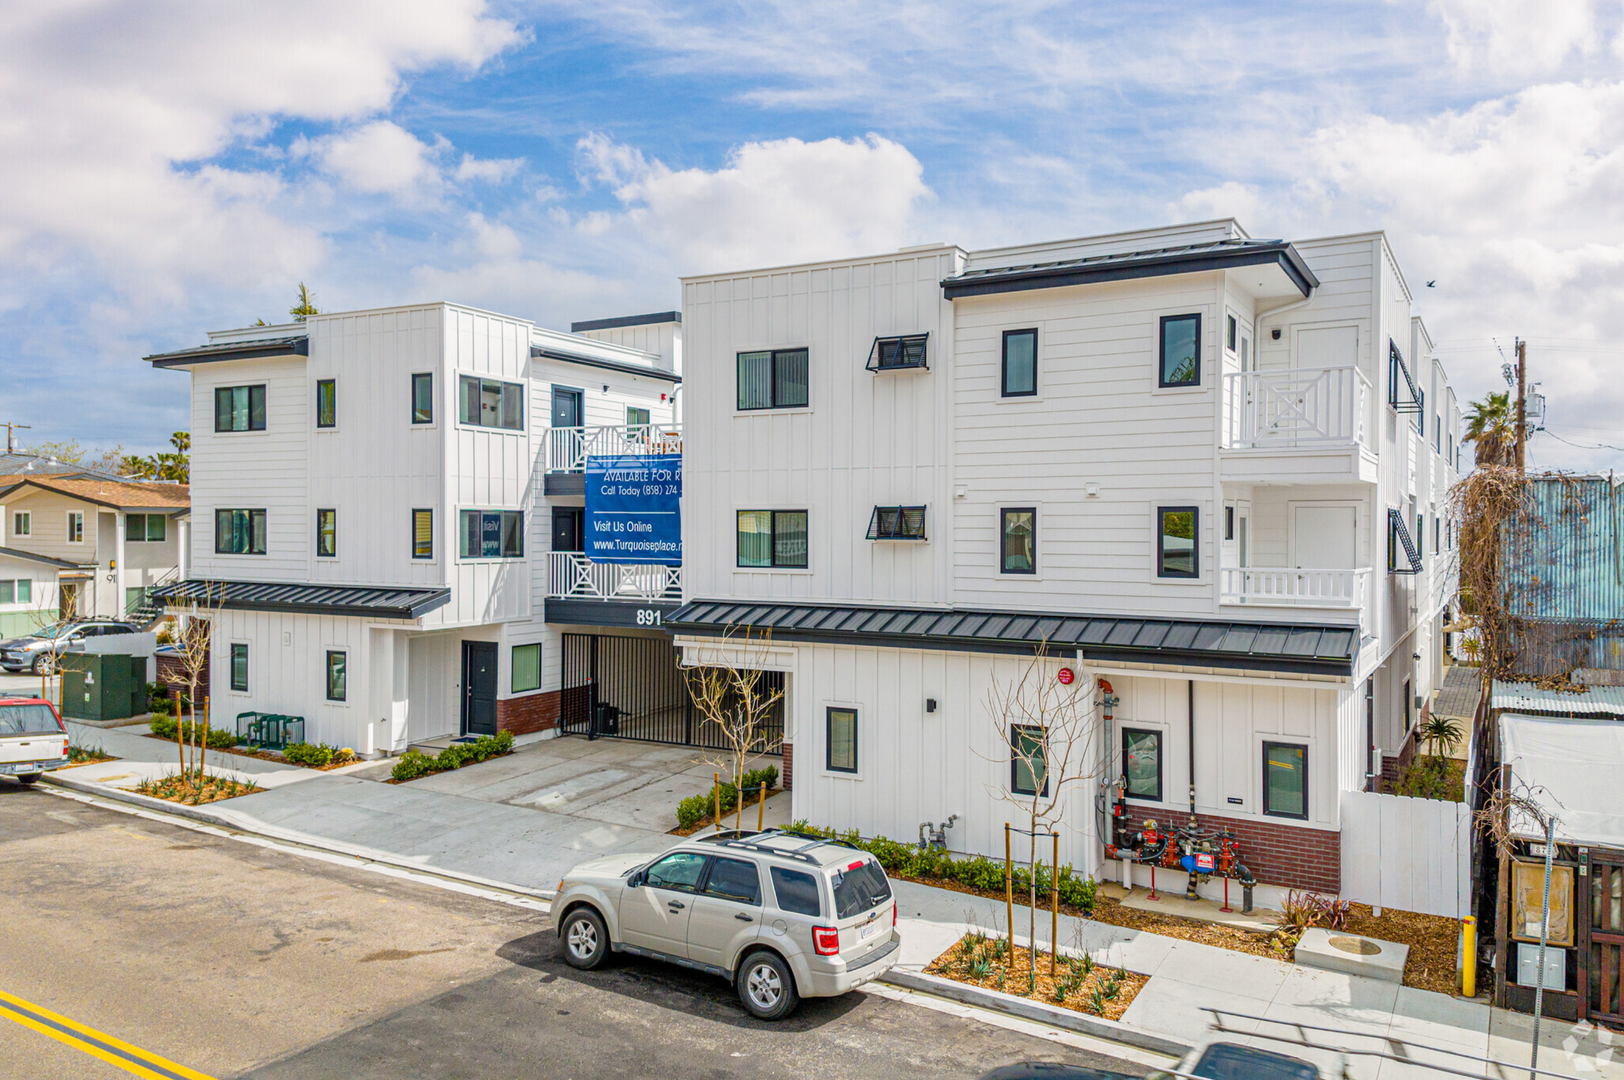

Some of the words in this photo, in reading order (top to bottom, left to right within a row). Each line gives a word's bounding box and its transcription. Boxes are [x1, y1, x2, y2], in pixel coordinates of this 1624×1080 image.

[603, 471, 649, 482] AVAILABLE
[652, 470, 672, 482] FOR
[600, 485, 615, 495] Call
[618, 486, 641, 498] Today
[643, 485, 663, 496] (858)
[665, 485, 678, 496] 274
[593, 521, 611, 532] Visit
[613, 521, 625, 532] Us
[626, 521, 653, 533] Online
[106, 573, 118, 584] 91
[636, 609, 661, 626] 891
